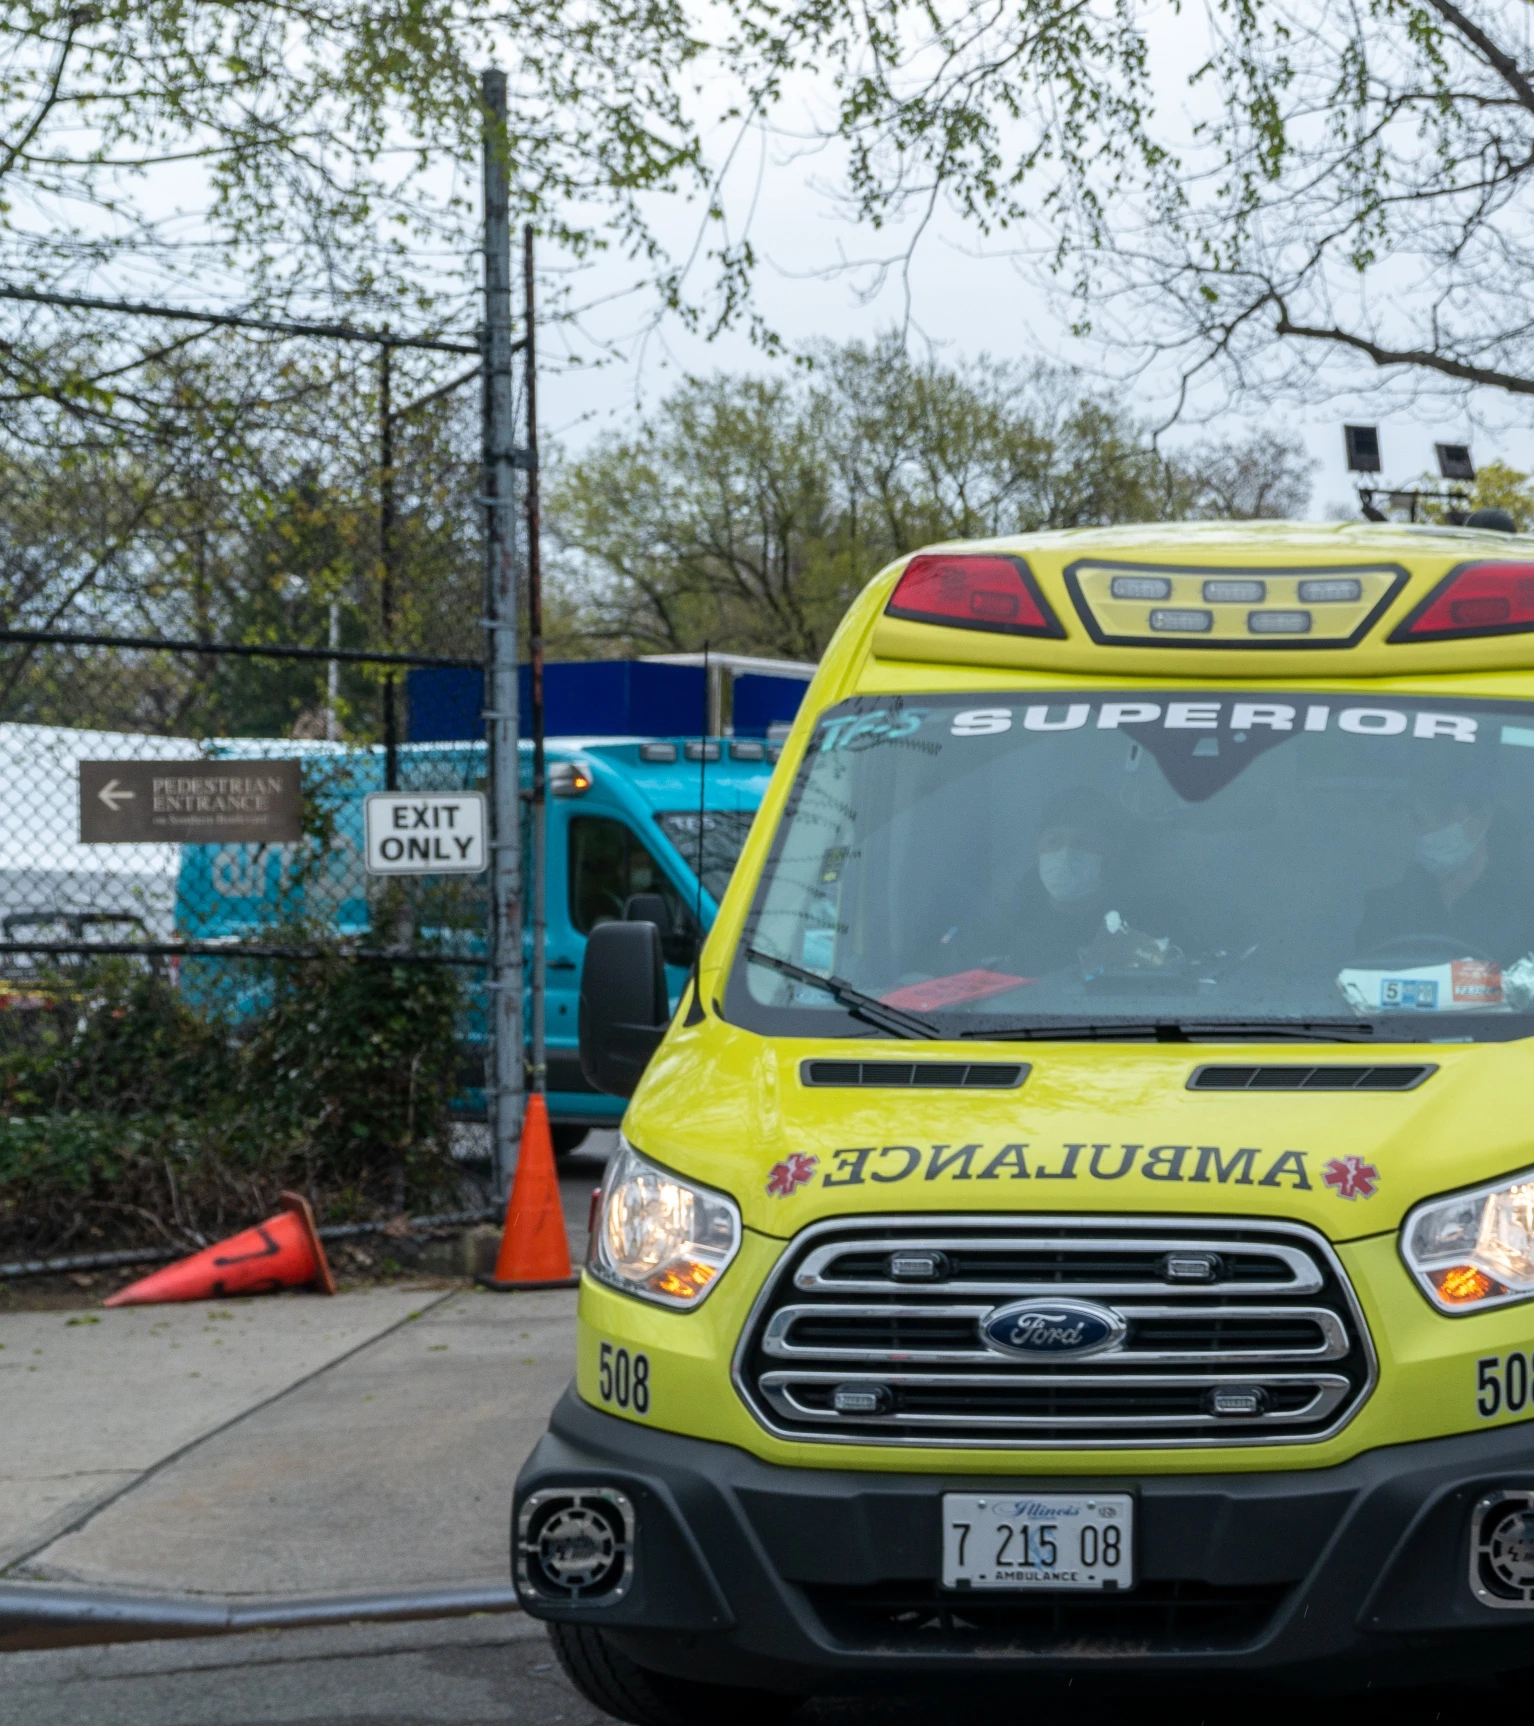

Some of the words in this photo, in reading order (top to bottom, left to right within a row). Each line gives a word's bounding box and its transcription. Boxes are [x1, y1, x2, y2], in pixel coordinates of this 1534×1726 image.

[950, 702, 1478, 744] SUPERIOR
[152, 776, 283, 795] PEDESTRIAN
[152, 795, 269, 812] ENTRANCE
[392, 806, 460, 829] EXIT
[379, 837, 474, 861] ONLY
[1009, 1312, 1086, 1345] Ford
[599, 1341, 649, 1414] 508
[1011, 1499, 1081, 1518] Illinois
[952, 1523, 971, 1567] 7
[995, 1524, 1058, 1567] 215
[1080, 1524, 1121, 1567] 08
[995, 1571, 1079, 1582] AMBULANCE
